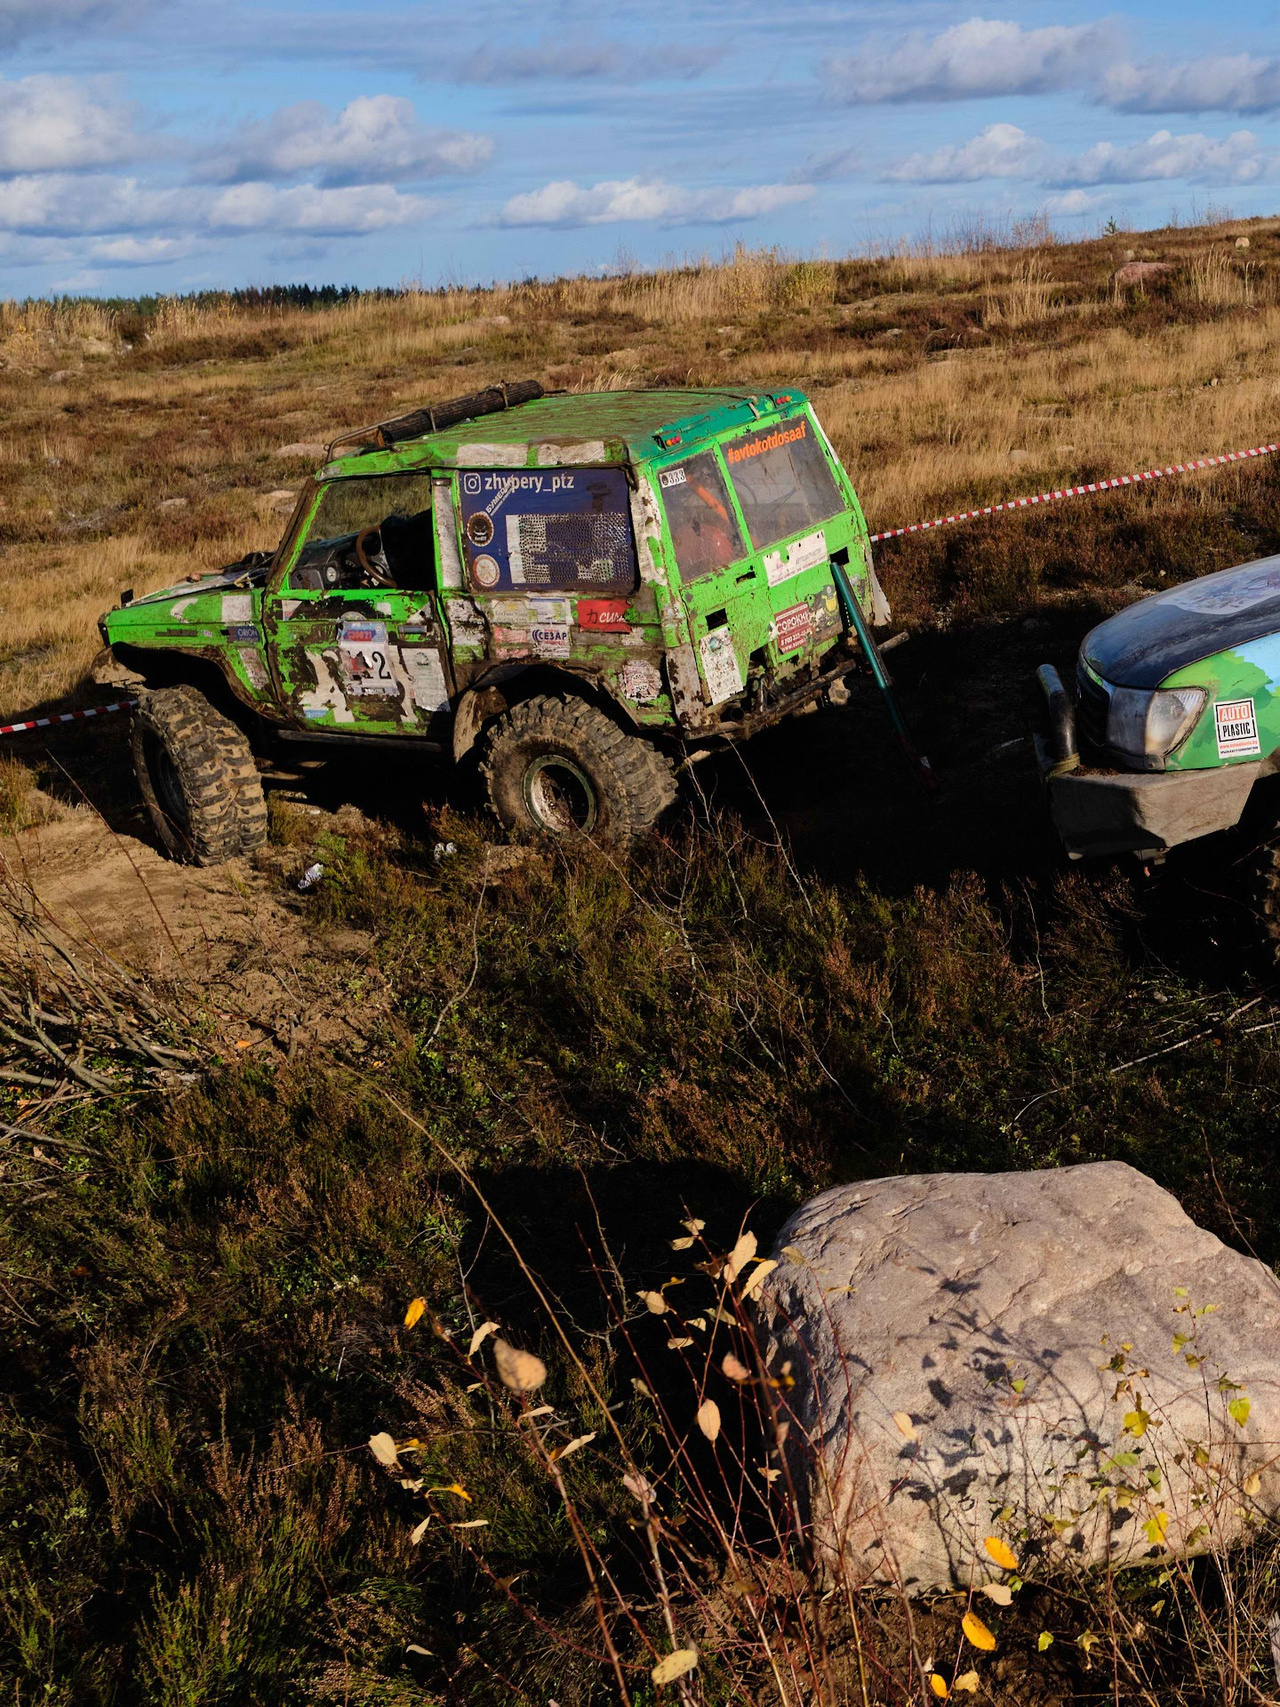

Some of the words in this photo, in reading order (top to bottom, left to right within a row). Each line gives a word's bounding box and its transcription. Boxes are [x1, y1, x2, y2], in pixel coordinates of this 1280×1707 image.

[727, 420, 806, 465] #avtokotdosaaf
[484, 472, 575, 494] zhypery_ptz
[538, 628, 567, 641] СЕЗАР
[1221, 705, 1249, 722] AUTO
[1222, 721, 1251, 737] PLASTIC
